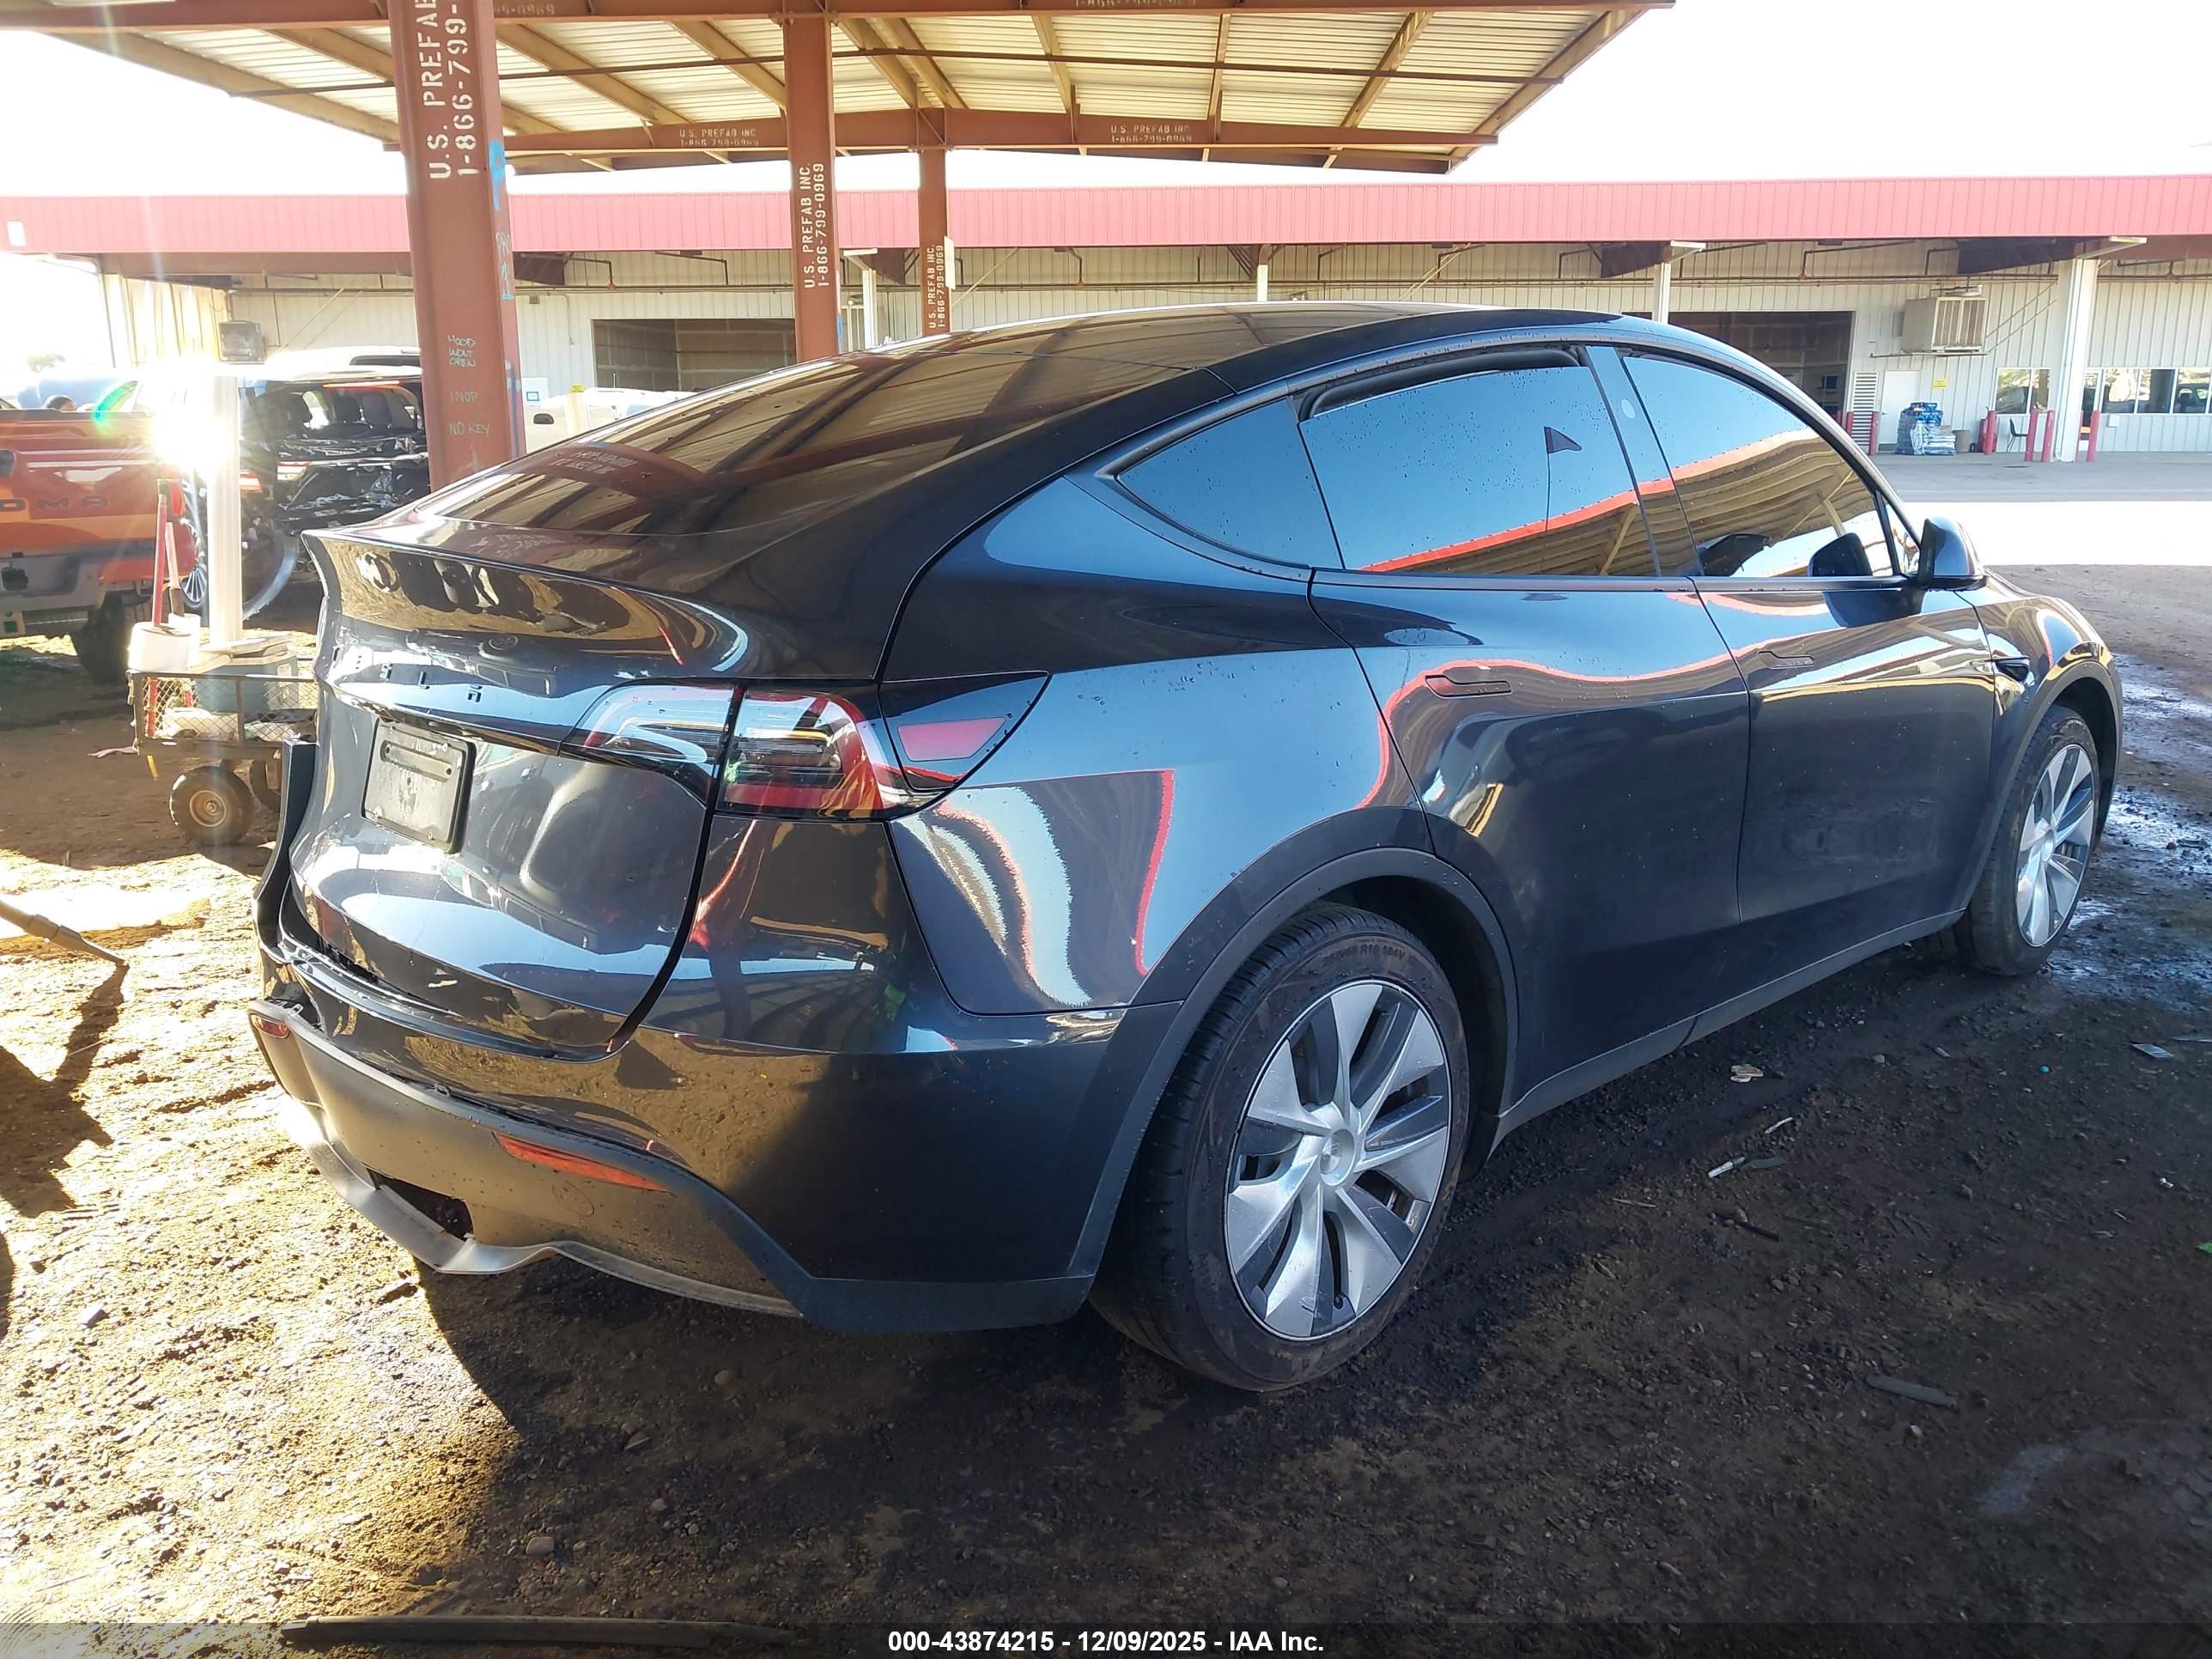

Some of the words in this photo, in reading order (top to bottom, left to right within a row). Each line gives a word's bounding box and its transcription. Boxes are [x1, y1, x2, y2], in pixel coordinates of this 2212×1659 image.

[427, 125, 452, 179] U.S.
[702, 128, 738, 138] PREFAB
[800, 197, 814, 253] PREFAB
[812, 163, 830, 287] 1-866-799-0969
[804, 261, 816, 289] U.S.
[927, 267, 936, 305] PREFAB
[936, 245, 946, 327] 1-866-799-0969
